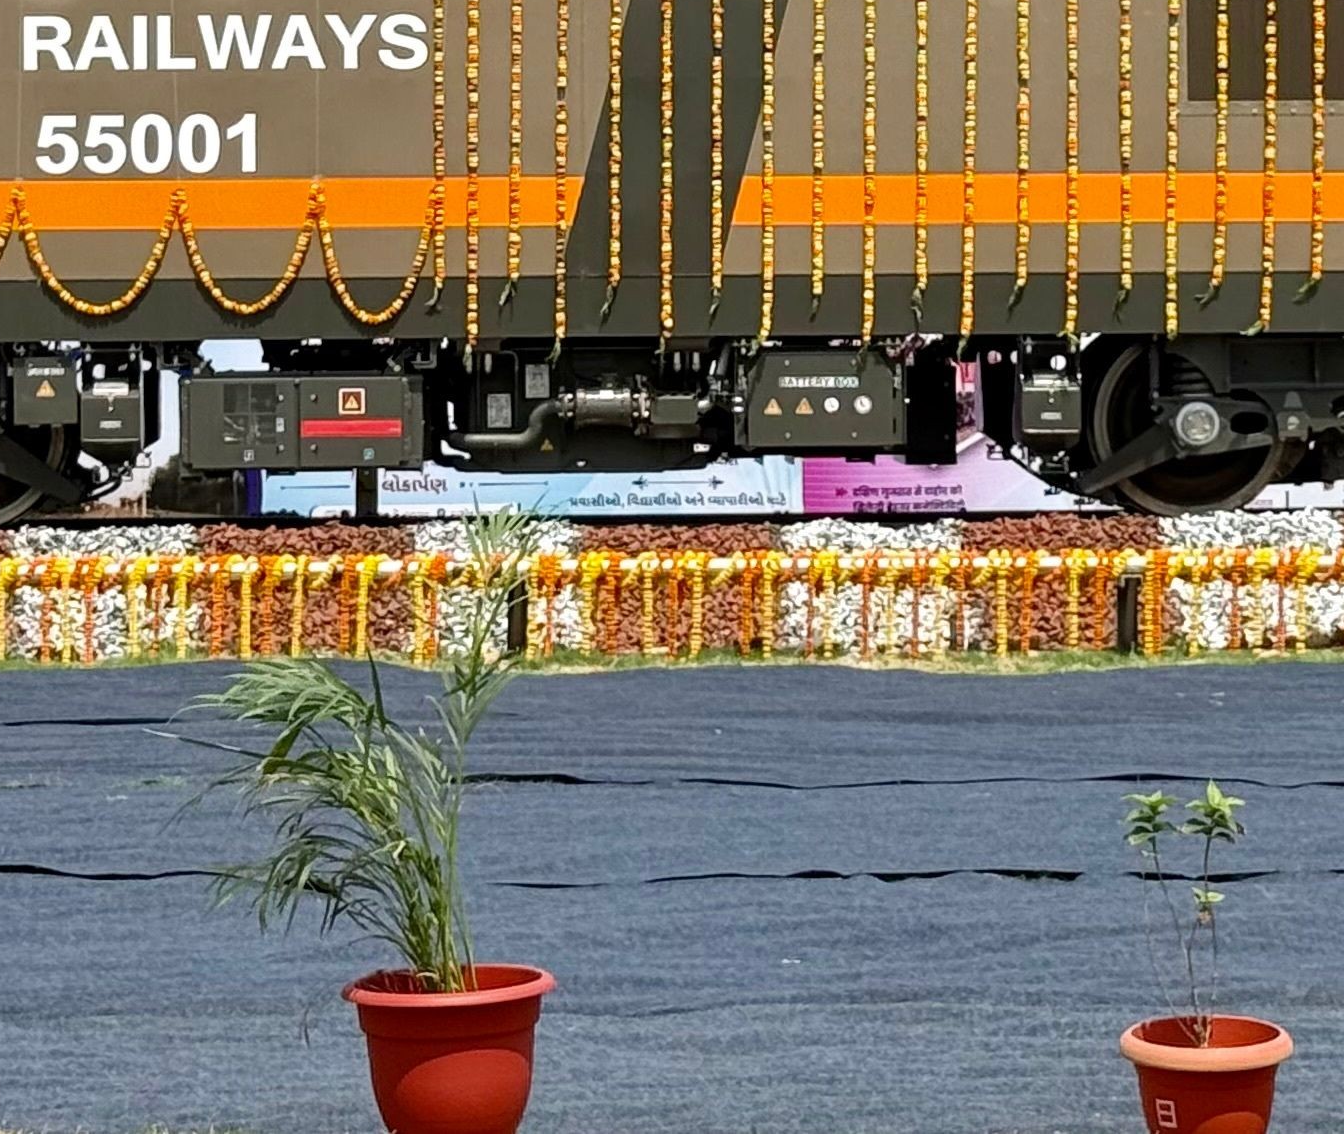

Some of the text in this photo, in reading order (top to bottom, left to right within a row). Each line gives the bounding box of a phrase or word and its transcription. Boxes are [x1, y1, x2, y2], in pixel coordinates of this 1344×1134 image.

[23, 13, 429, 71] RAILWAYS
[35, 113, 257, 175] 55001
[382, 474, 448, 495] લોકાર્પણ
